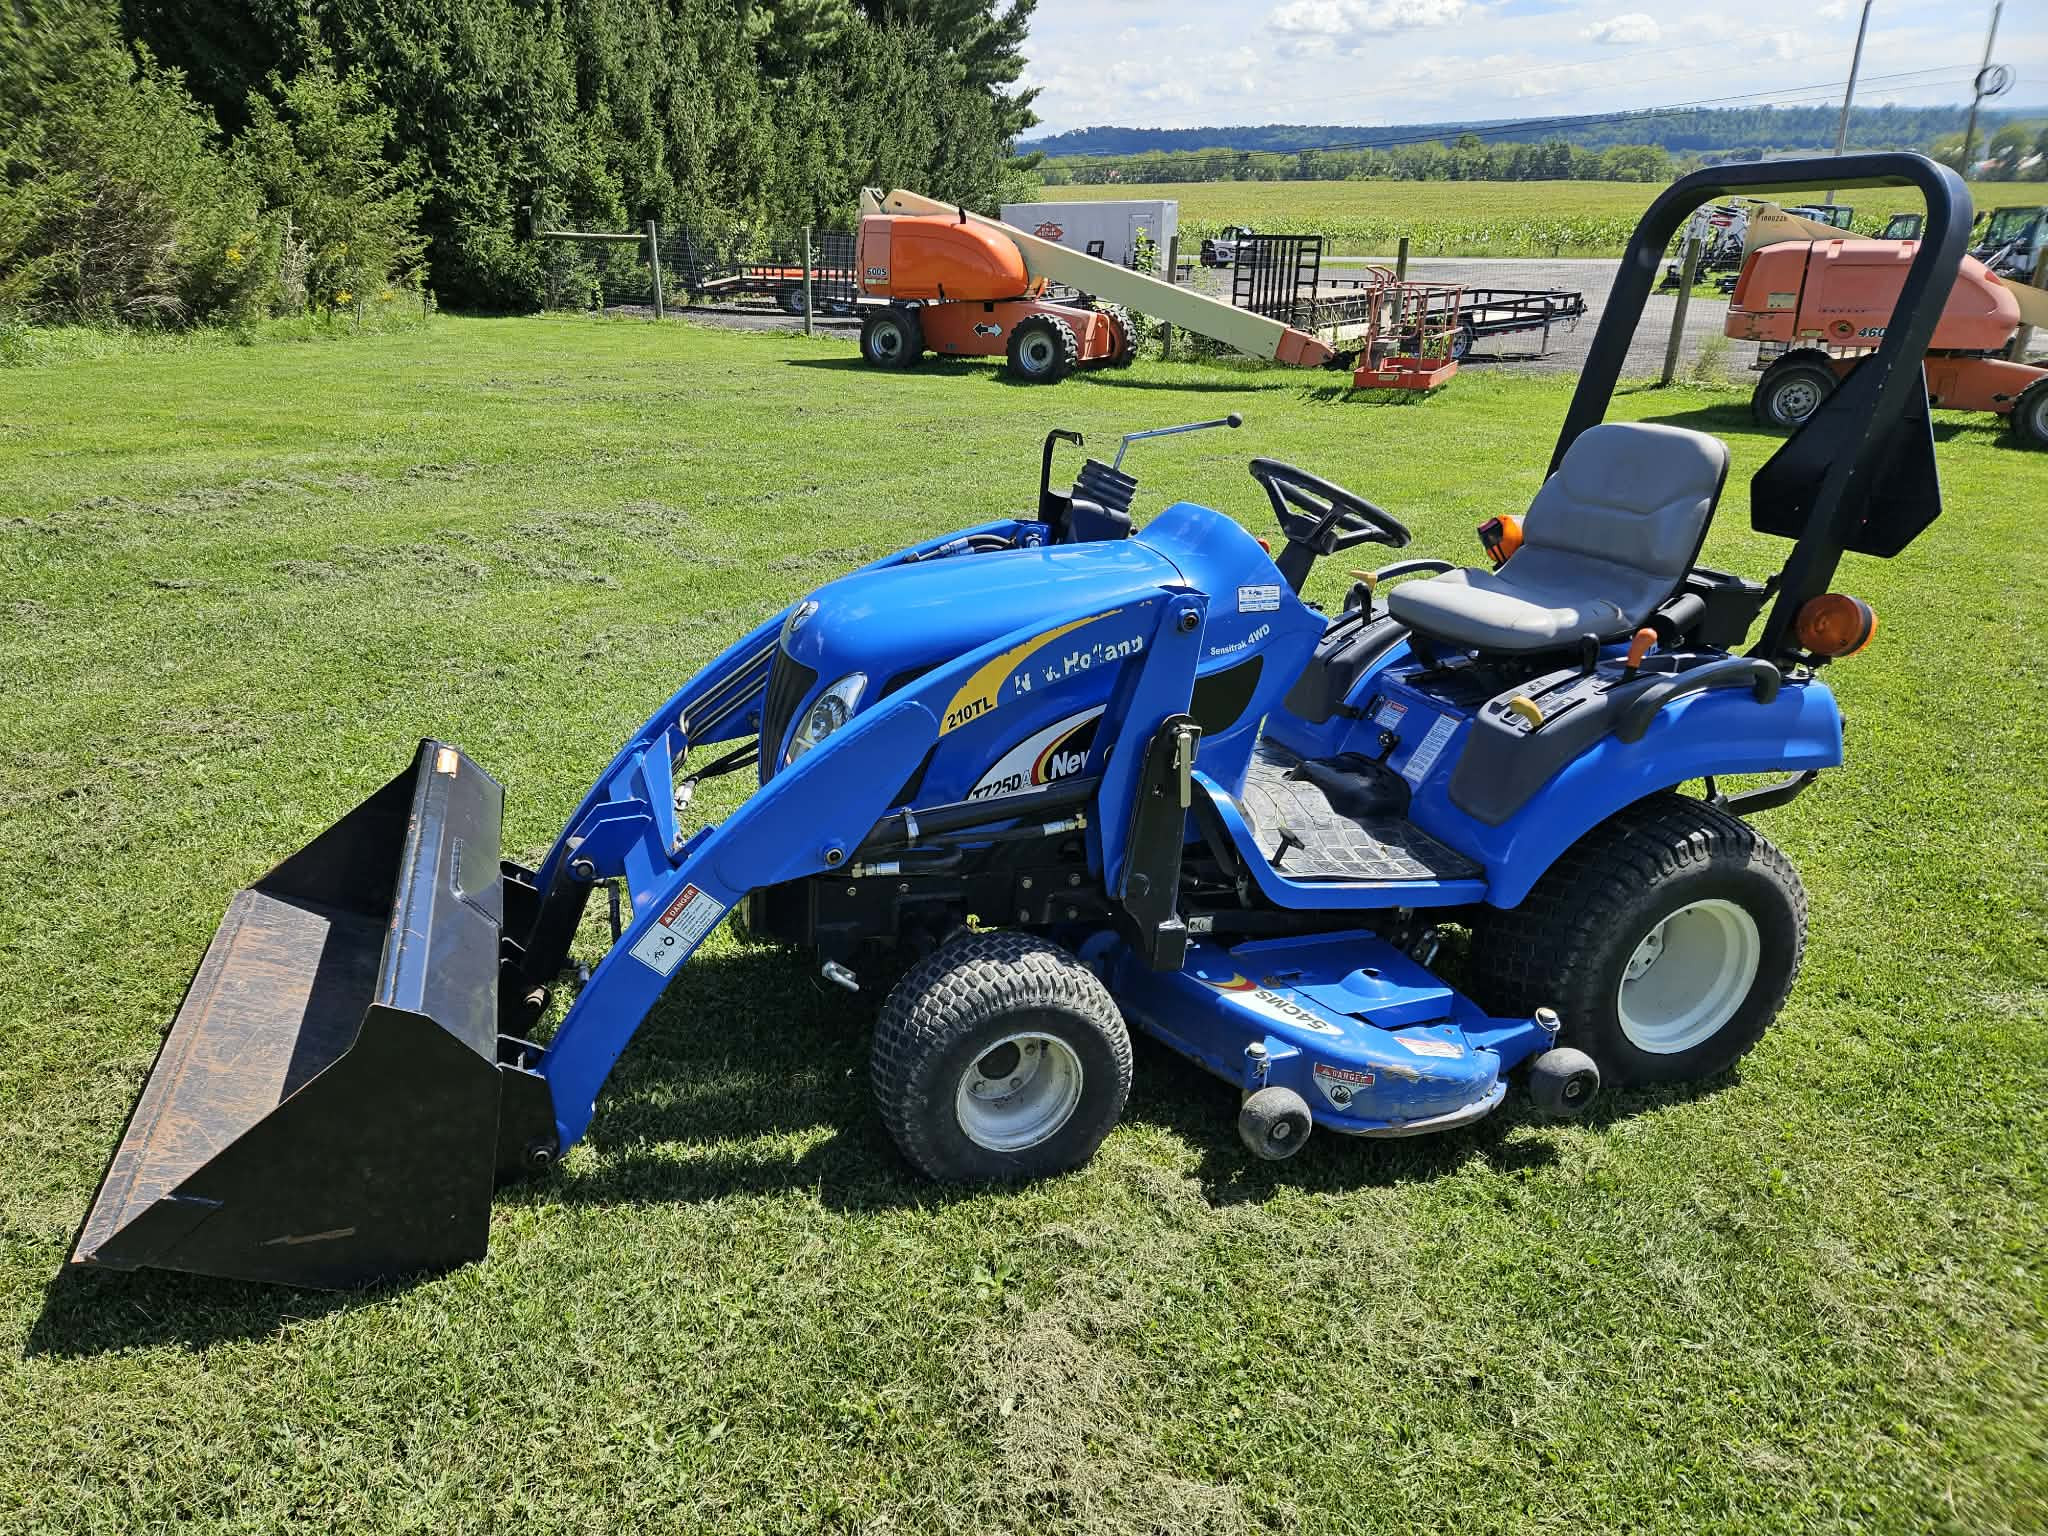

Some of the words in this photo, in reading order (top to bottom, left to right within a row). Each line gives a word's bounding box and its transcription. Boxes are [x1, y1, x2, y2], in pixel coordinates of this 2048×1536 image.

[1210, 640, 1247, 656] Sensitrak
[1248, 624, 1270, 643] 4WD
[947, 696, 993, 729] 210TL
[669, 889, 694, 916] DANGER
[1255, 990, 1328, 1029] 54CMS
